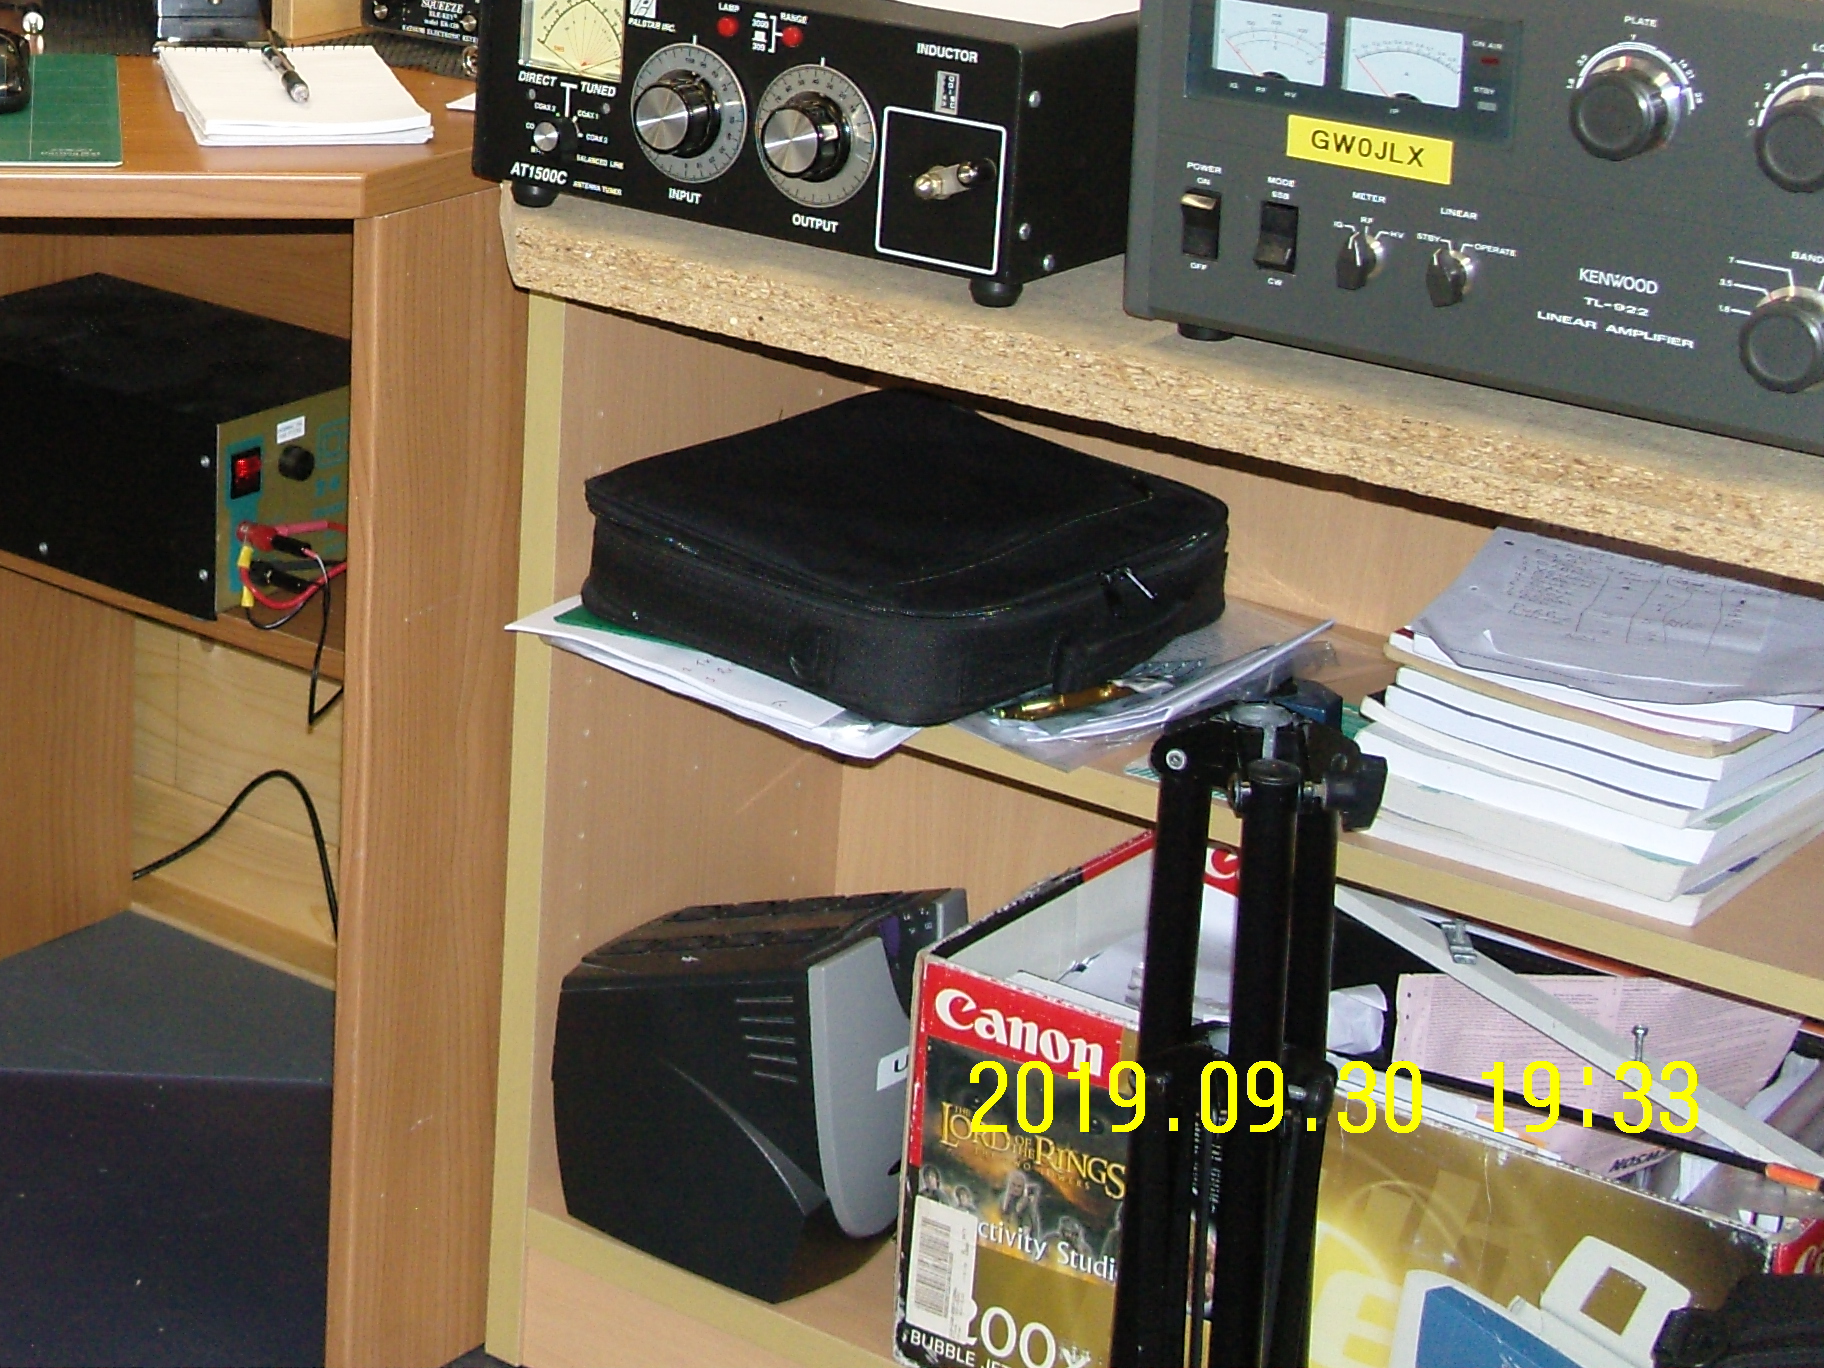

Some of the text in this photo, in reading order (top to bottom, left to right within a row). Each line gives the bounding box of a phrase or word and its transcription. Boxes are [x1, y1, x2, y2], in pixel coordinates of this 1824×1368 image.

[718, 1, 740, 12] LAMP
[628, 17, 658, 31] PALSTAR
[780, 12, 808, 25] RANGE
[1623, 15, 1659, 28] PLATE
[916, 42, 978, 64] INDUCTOR
[518, 70, 558, 87] DIRECT
[580, 80, 617, 98] TUNED
[576, 153, 608, 166] BALANCED
[1186, 161, 1222, 175] POWER
[510, 161, 569, 185] AT1500C
[572, 180, 599, 192] ANTENNA
[1267, 176, 1295, 188] MODE
[668, 188, 702, 205] INPUT
[1352, 191, 1387, 204] METER
[1440, 207, 1478, 220] LINEAR
[792, 213, 839, 233] OUTPUT
[1416, 232, 1441, 243] STBY
[1474, 243, 1518, 257] OPERATE
[1578, 267, 1659, 295] KENWOOD
[1583, 296, 1650, 318] TL-922
[1537, 310, 1696, 350] LINEAR AMPLIFIER
[935, 988, 1104, 1077] Canon
[940, 1102, 1012, 1150] LORD
[1034, 1134, 1127, 1199] RINGS
[976, 1219, 1119, 1282] ctivity Studi
[910, 1328, 976, 1367] BUBBLE
